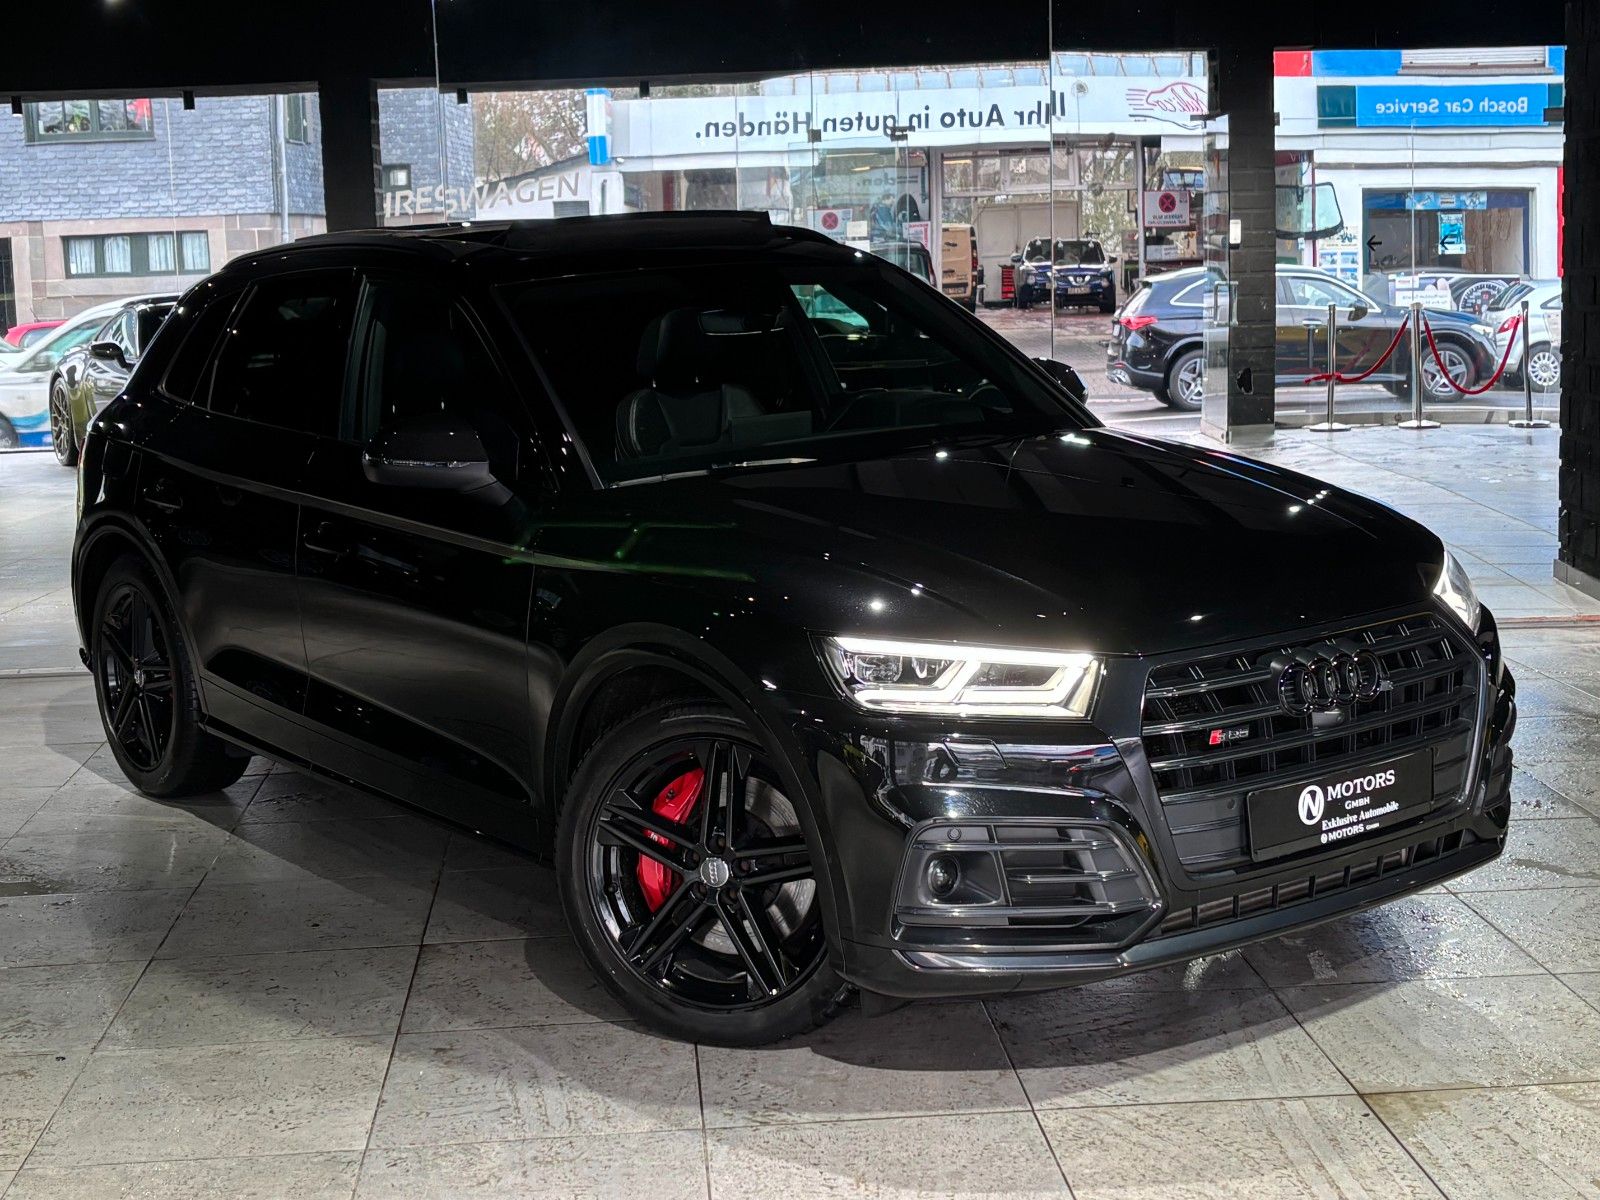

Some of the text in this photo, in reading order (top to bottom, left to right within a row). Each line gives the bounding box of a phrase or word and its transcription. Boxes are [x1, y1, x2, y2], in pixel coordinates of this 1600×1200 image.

[1326, 769, 1396, 802] MOTORS
[1321, 800, 1400, 831] Exklusive Automobile
[1344, 796, 1371, 810] GMBH
[1328, 823, 1365, 842] MOTORS
